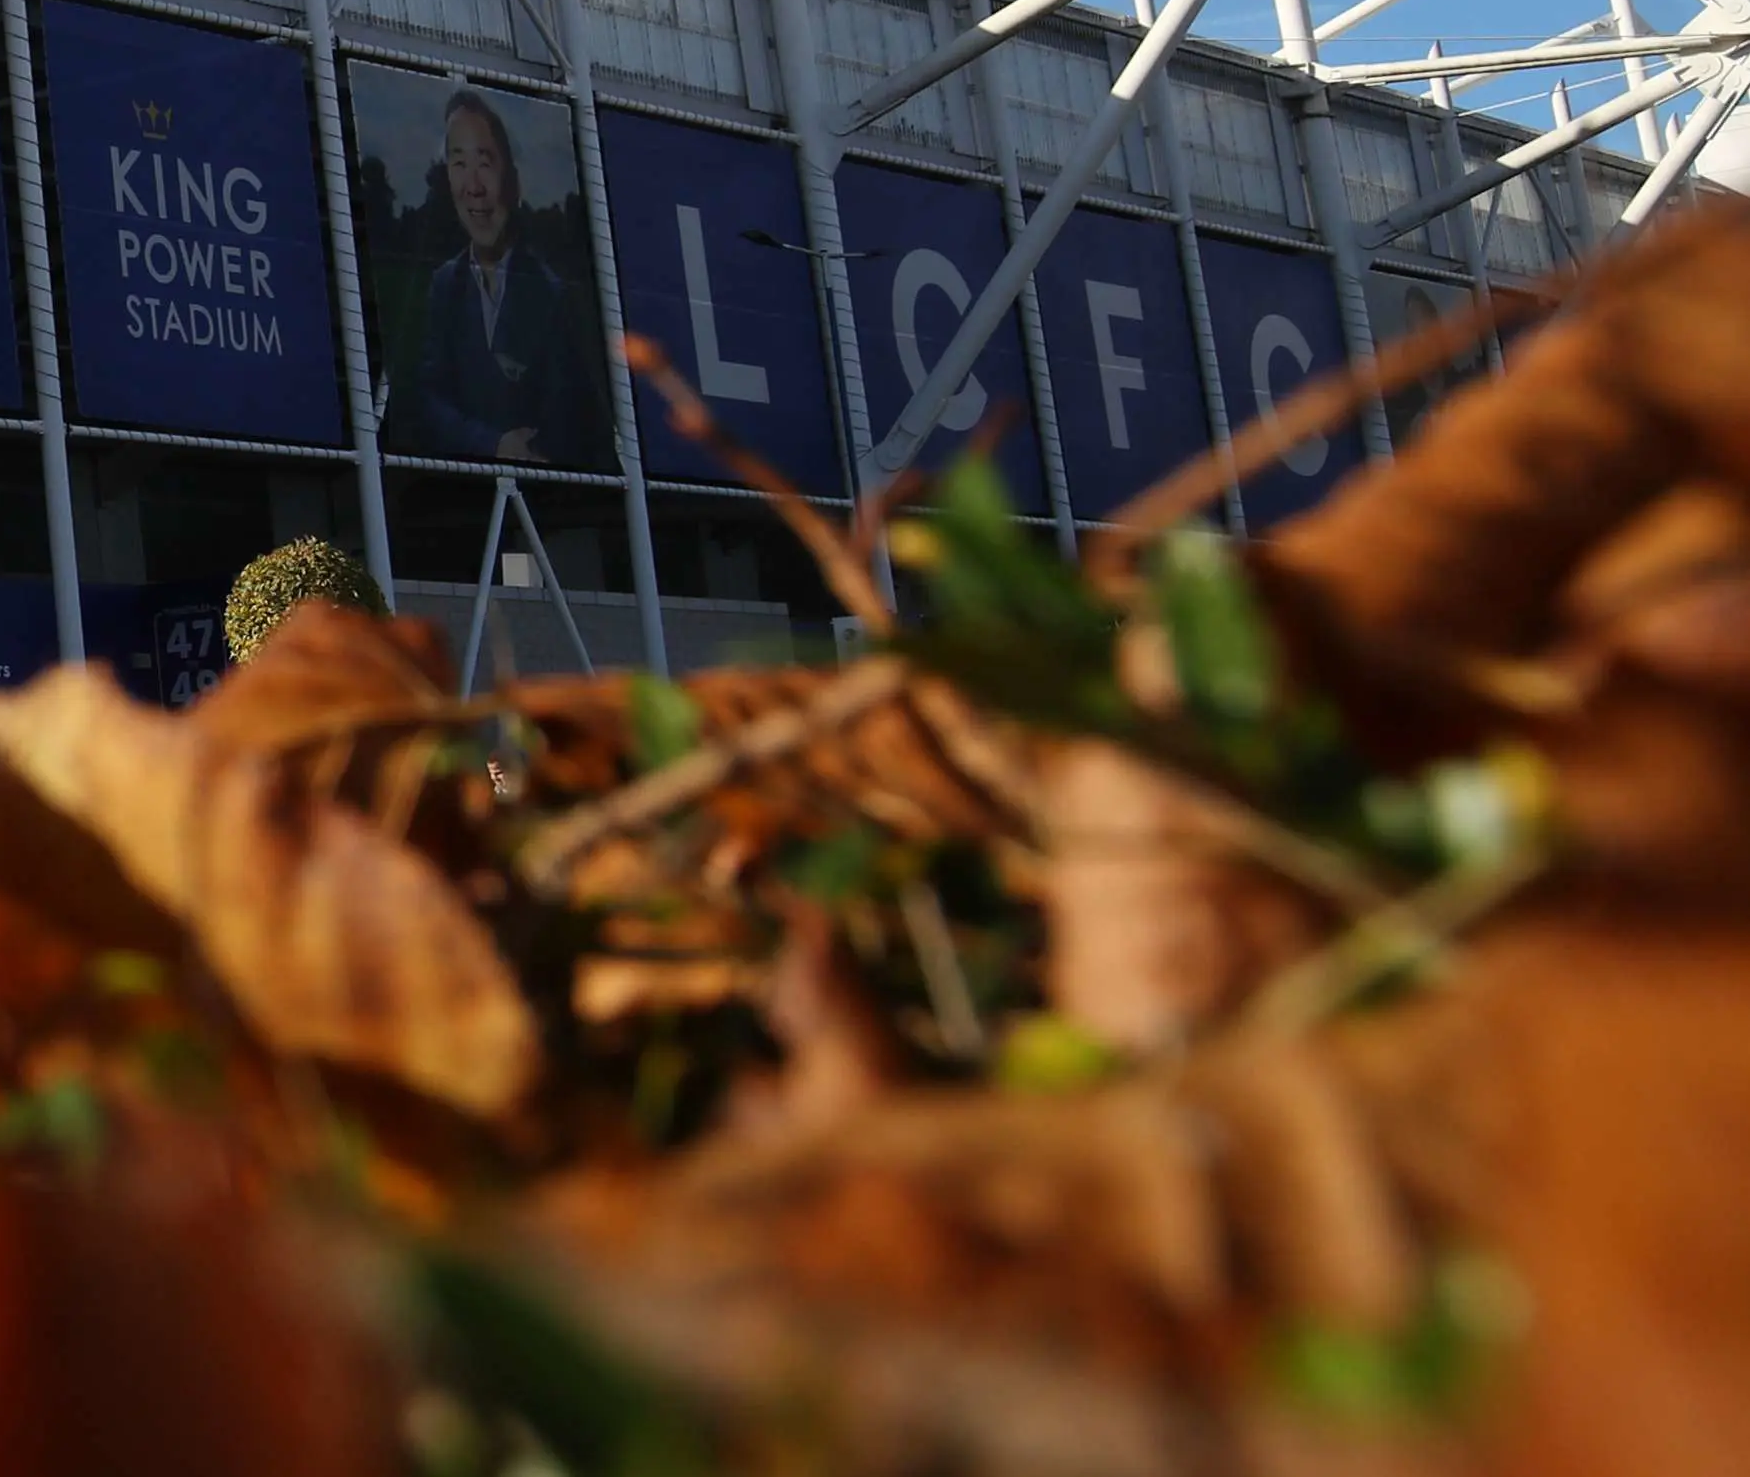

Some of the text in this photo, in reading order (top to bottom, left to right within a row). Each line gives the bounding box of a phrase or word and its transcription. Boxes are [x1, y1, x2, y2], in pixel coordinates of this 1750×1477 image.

[109, 144, 269, 236] KING
[117, 228, 277, 300] POWER
[125, 293, 284, 357] STADIUM
[166, 618, 214, 660] 47
